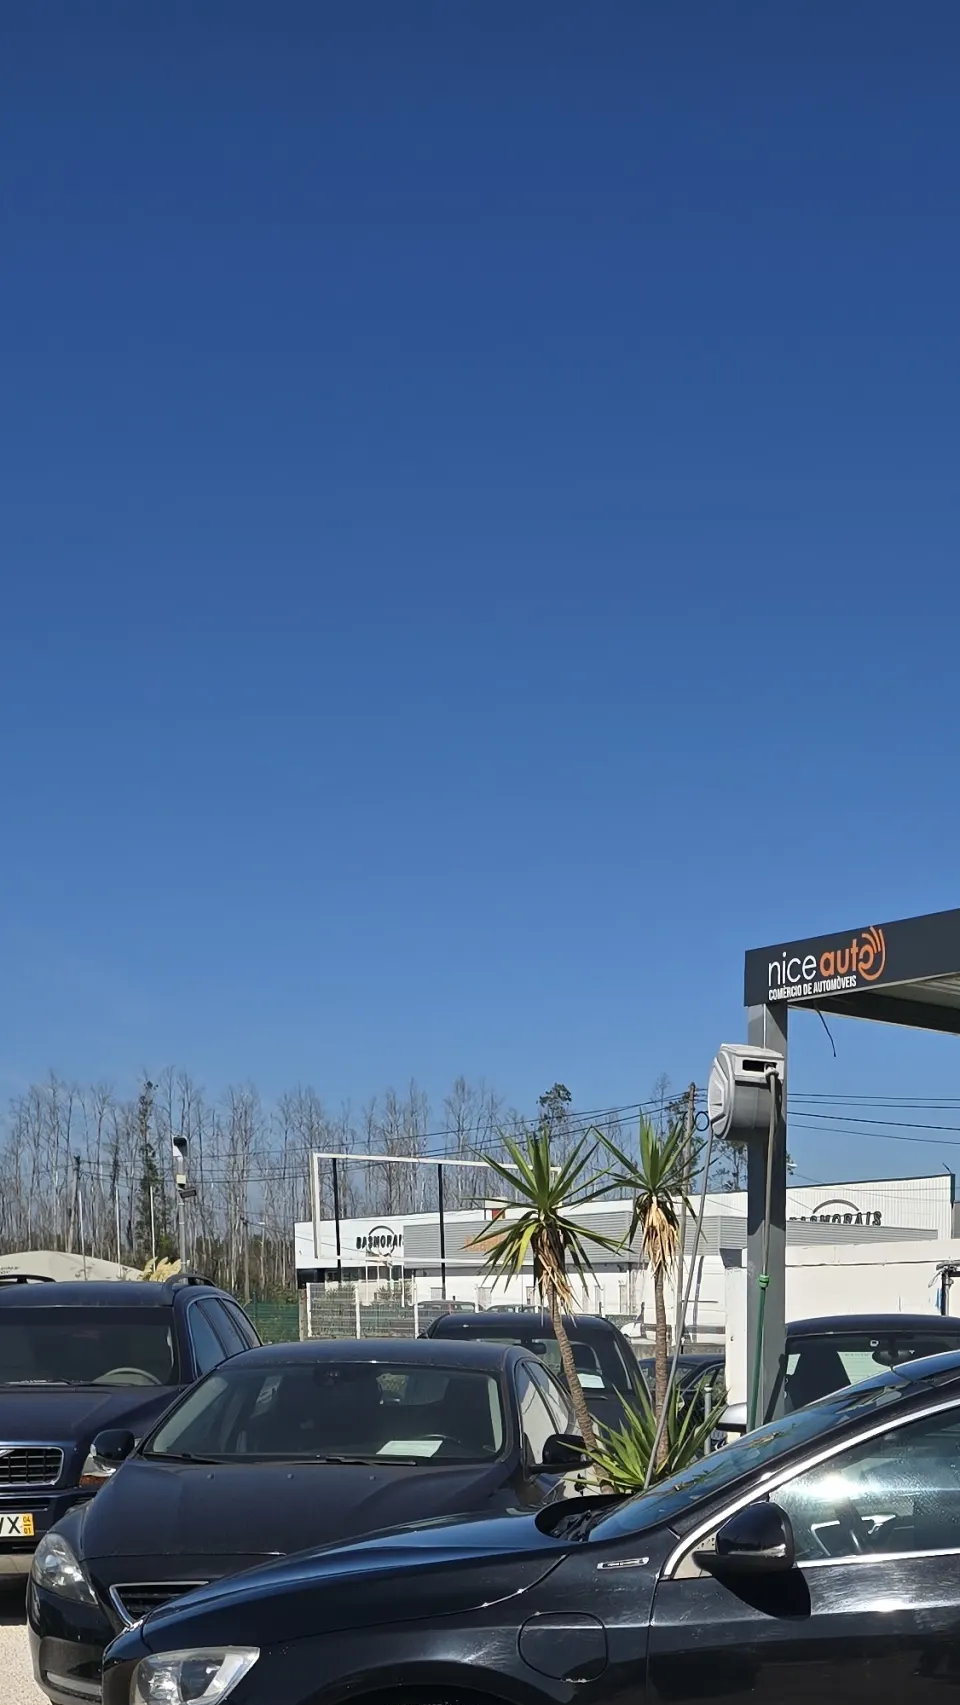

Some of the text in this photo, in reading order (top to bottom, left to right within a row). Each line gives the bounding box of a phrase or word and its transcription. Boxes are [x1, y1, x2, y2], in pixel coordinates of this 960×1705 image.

[768, 933, 882, 987] nice auto
[802, 983, 813, 996] DE
[356, 1234, 404, 1250] BASMORAI
